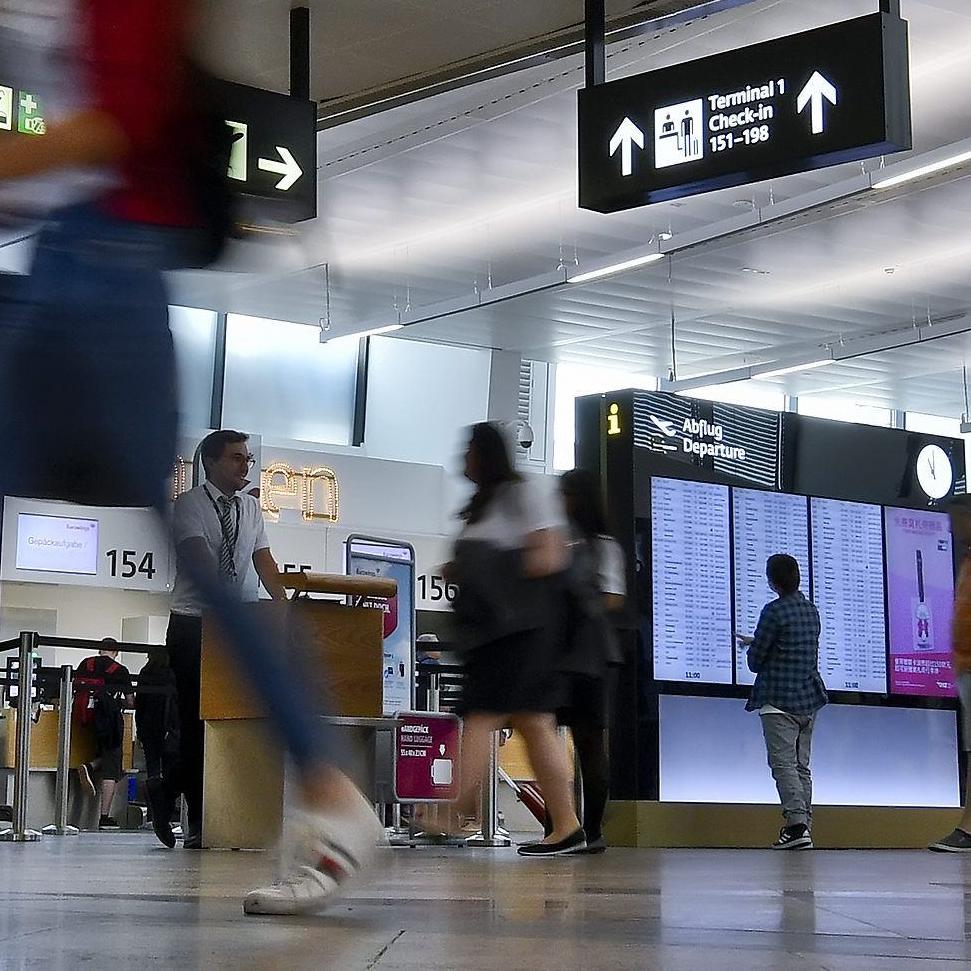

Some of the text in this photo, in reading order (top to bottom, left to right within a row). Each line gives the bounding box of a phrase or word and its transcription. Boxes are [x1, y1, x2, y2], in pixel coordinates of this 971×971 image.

[708, 79, 785, 111] Terminal 1
[709, 103, 773, 132] Check-in
[682, 418, 723, 441] Abflug
[682, 437, 746, 460] Departure
[106, 549, 156, 579] 154
[417, 574, 457, 602] 156
